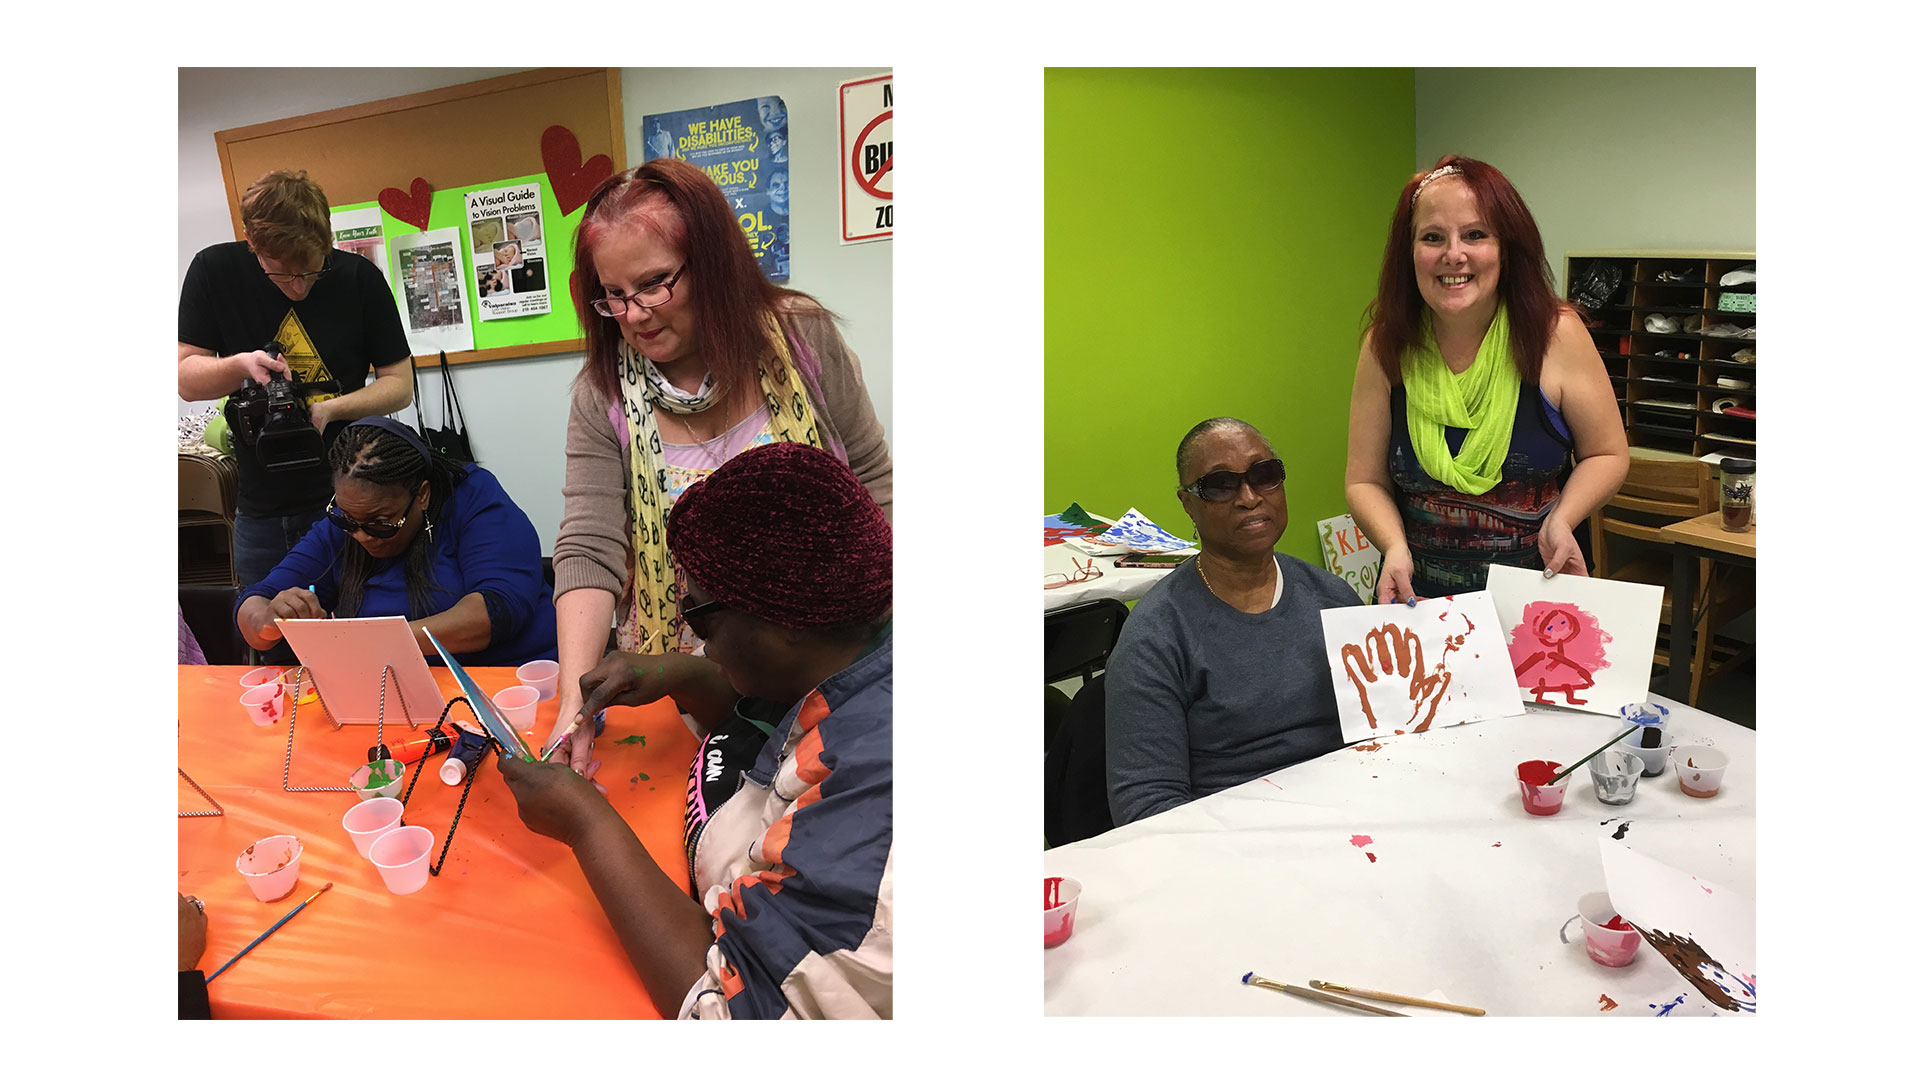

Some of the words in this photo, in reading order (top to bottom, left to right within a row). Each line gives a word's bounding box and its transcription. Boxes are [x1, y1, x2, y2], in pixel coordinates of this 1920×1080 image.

[688, 121, 707, 135] WE
[710, 115, 742, 132] HAVE
[679, 126, 756, 149] DISABILITIES,
[732, 158, 759, 173] YOU
[470, 198, 478, 208] A
[479, 192, 505, 206] Visual
[507, 188, 535, 202] Guide
[480, 208, 502, 217] Vision
[502, 203, 536, 214] Problems
[1335, 525, 1370, 556] KE
